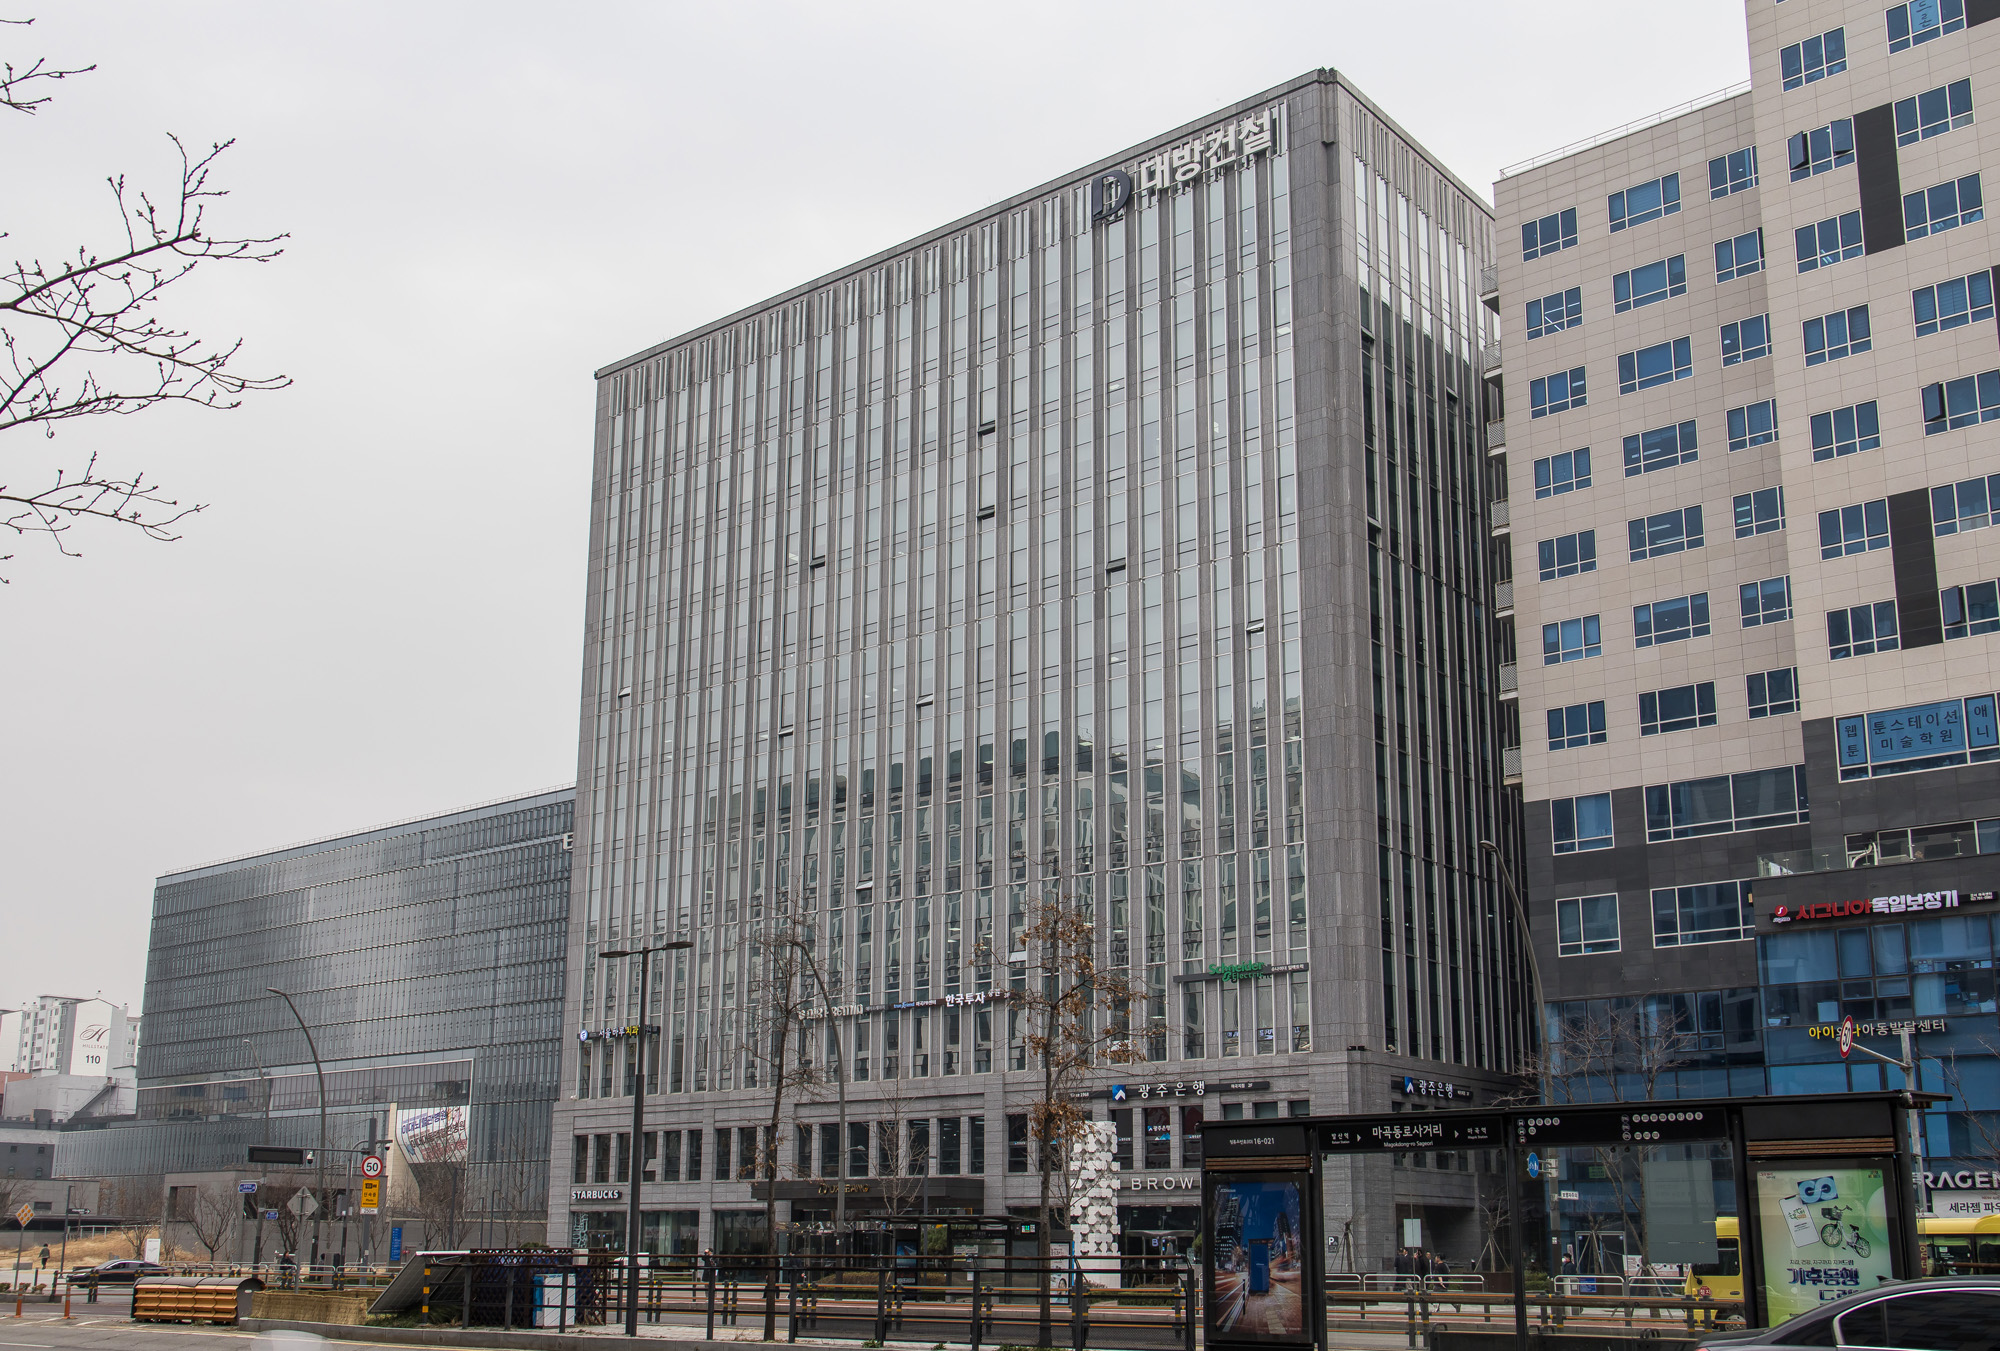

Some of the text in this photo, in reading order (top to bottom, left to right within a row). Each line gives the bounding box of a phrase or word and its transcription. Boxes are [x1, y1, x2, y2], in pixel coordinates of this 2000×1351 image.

[1140, 109, 1272, 190] 대방건설
[1872, 710, 1959, 735] 툰스테이션
[1880, 729, 1954, 751] 미술학원
[1208, 960, 1264, 975] Schneider
[945, 991, 986, 1007] 한국투자
[85, 1055, 101, 1064] 110
[1138, 1081, 1205, 1099] 광주은행
[1418, 1080, 1453, 1098] 광주은행
[1372, 1123, 1443, 1140] 마곡동로사거리
[1253, 1137, 1275, 1145] 16-021
[366, 1162, 379, 1172] 50
[571, 1190, 619, 1199] STARBUCKS
[1949, 1202, 1981, 1213] 세라젬
[1787, 1267, 1860, 1286] 기후동행
